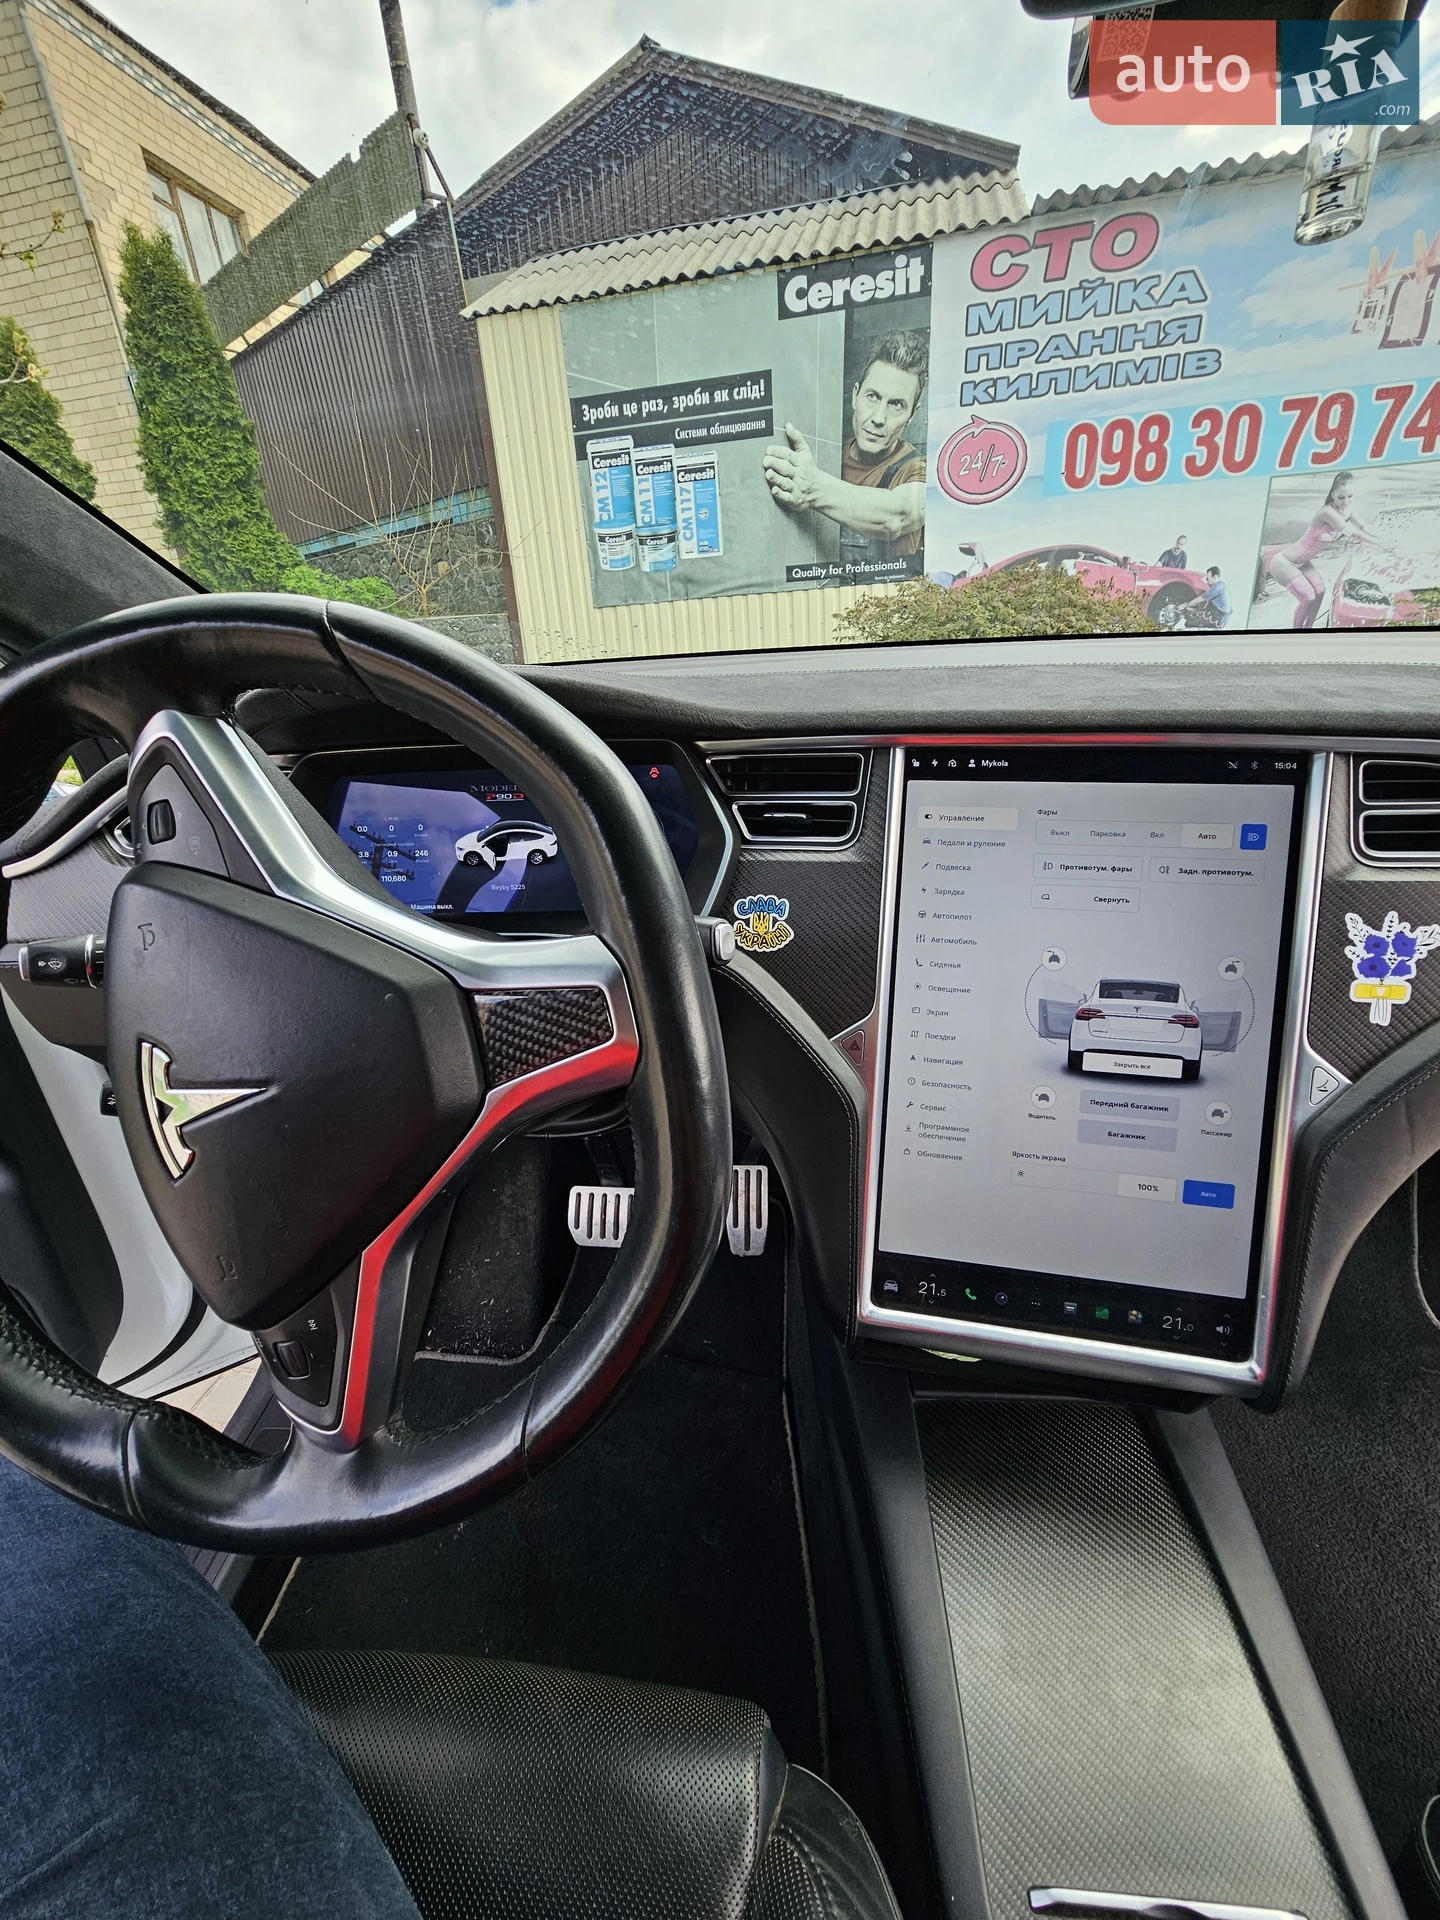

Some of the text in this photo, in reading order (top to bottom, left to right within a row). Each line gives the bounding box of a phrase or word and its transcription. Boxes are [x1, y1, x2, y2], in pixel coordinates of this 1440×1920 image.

[970, 211, 1160, 293] СТО
[784, 254, 925, 313] Ceresit
[965, 269, 1209, 337] МИЙКА
[964, 314, 1203, 374] ПРАННЯ
[959, 348, 1222, 407] КИЛИМІВ
[582, 378, 766, 424] Зроби це раз, зроби як слід!
[675, 419, 766, 440] Системи облицювання
[1064, 380, 1440, 489] 098 30 79 74
[593, 453, 630, 469] Ceresit
[637, 460, 672, 475] Ceresit
[678, 468, 715, 482] Ceresit
[594, 471, 609, 492] 12
[638, 477, 651, 495] 11
[680, 485, 692, 514] 117
[682, 516, 695, 542] CM
[792, 558, 907, 578] Quality for Professionals
[981, 759, 1008, 768] Mykola
[939, 814, 985, 823] Управление
[1037, 809, 1058, 817] Фары
[1050, 829, 1070, 837] Выкл
[1090, 830, 1126, 839] Парковка
[937, 839, 965, 848] Педали
[414, 849, 428, 857] 246
[935, 864, 971, 872] Подвеска
[1059, 864, 1133, 874] Противотум. фары
[1178, 867, 1254, 878] Задн. противотум.
[934, 888, 965, 896] Зарядка
[1093, 895, 1130, 905] Свернуть
[736, 896, 787, 918] СЛАВА
[932, 912, 973, 921] Автопилот
[931, 937, 978, 946] Автомобиль
[929, 961, 961, 969] Сиденья
[928, 985, 971, 994] Освещение
[926, 1008, 949, 1017] Экран
[924, 1032, 956, 1041] Поездки
[923, 1056, 963, 1066] Навигация
[1113, 1061, 1139, 1070] Закрыть
[921, 1080, 972, 1091] Безопасность
[920, 1103, 946, 1113] Сервис
[1090, 1099, 1169, 1113] Передний багажник
[1028, 1113, 1056, 1121] Водитель
[919, 1122, 970, 1134] Программное
[1201, 1129, 1232, 1138] Пассажир
[918, 1132, 966, 1143] обеспечение
[1107, 1131, 1146, 1141] Багажник
[917, 1150, 963, 1161] Обновления
[1012, 1150, 1066, 1163] Яркость экрана
[1138, 1183, 1159, 1192] 100%
[1200, 1191, 1217, 1199] Авто
[918, 1281, 947, 1298] 21.5
[1162, 1315, 1194, 1333] 21.0
